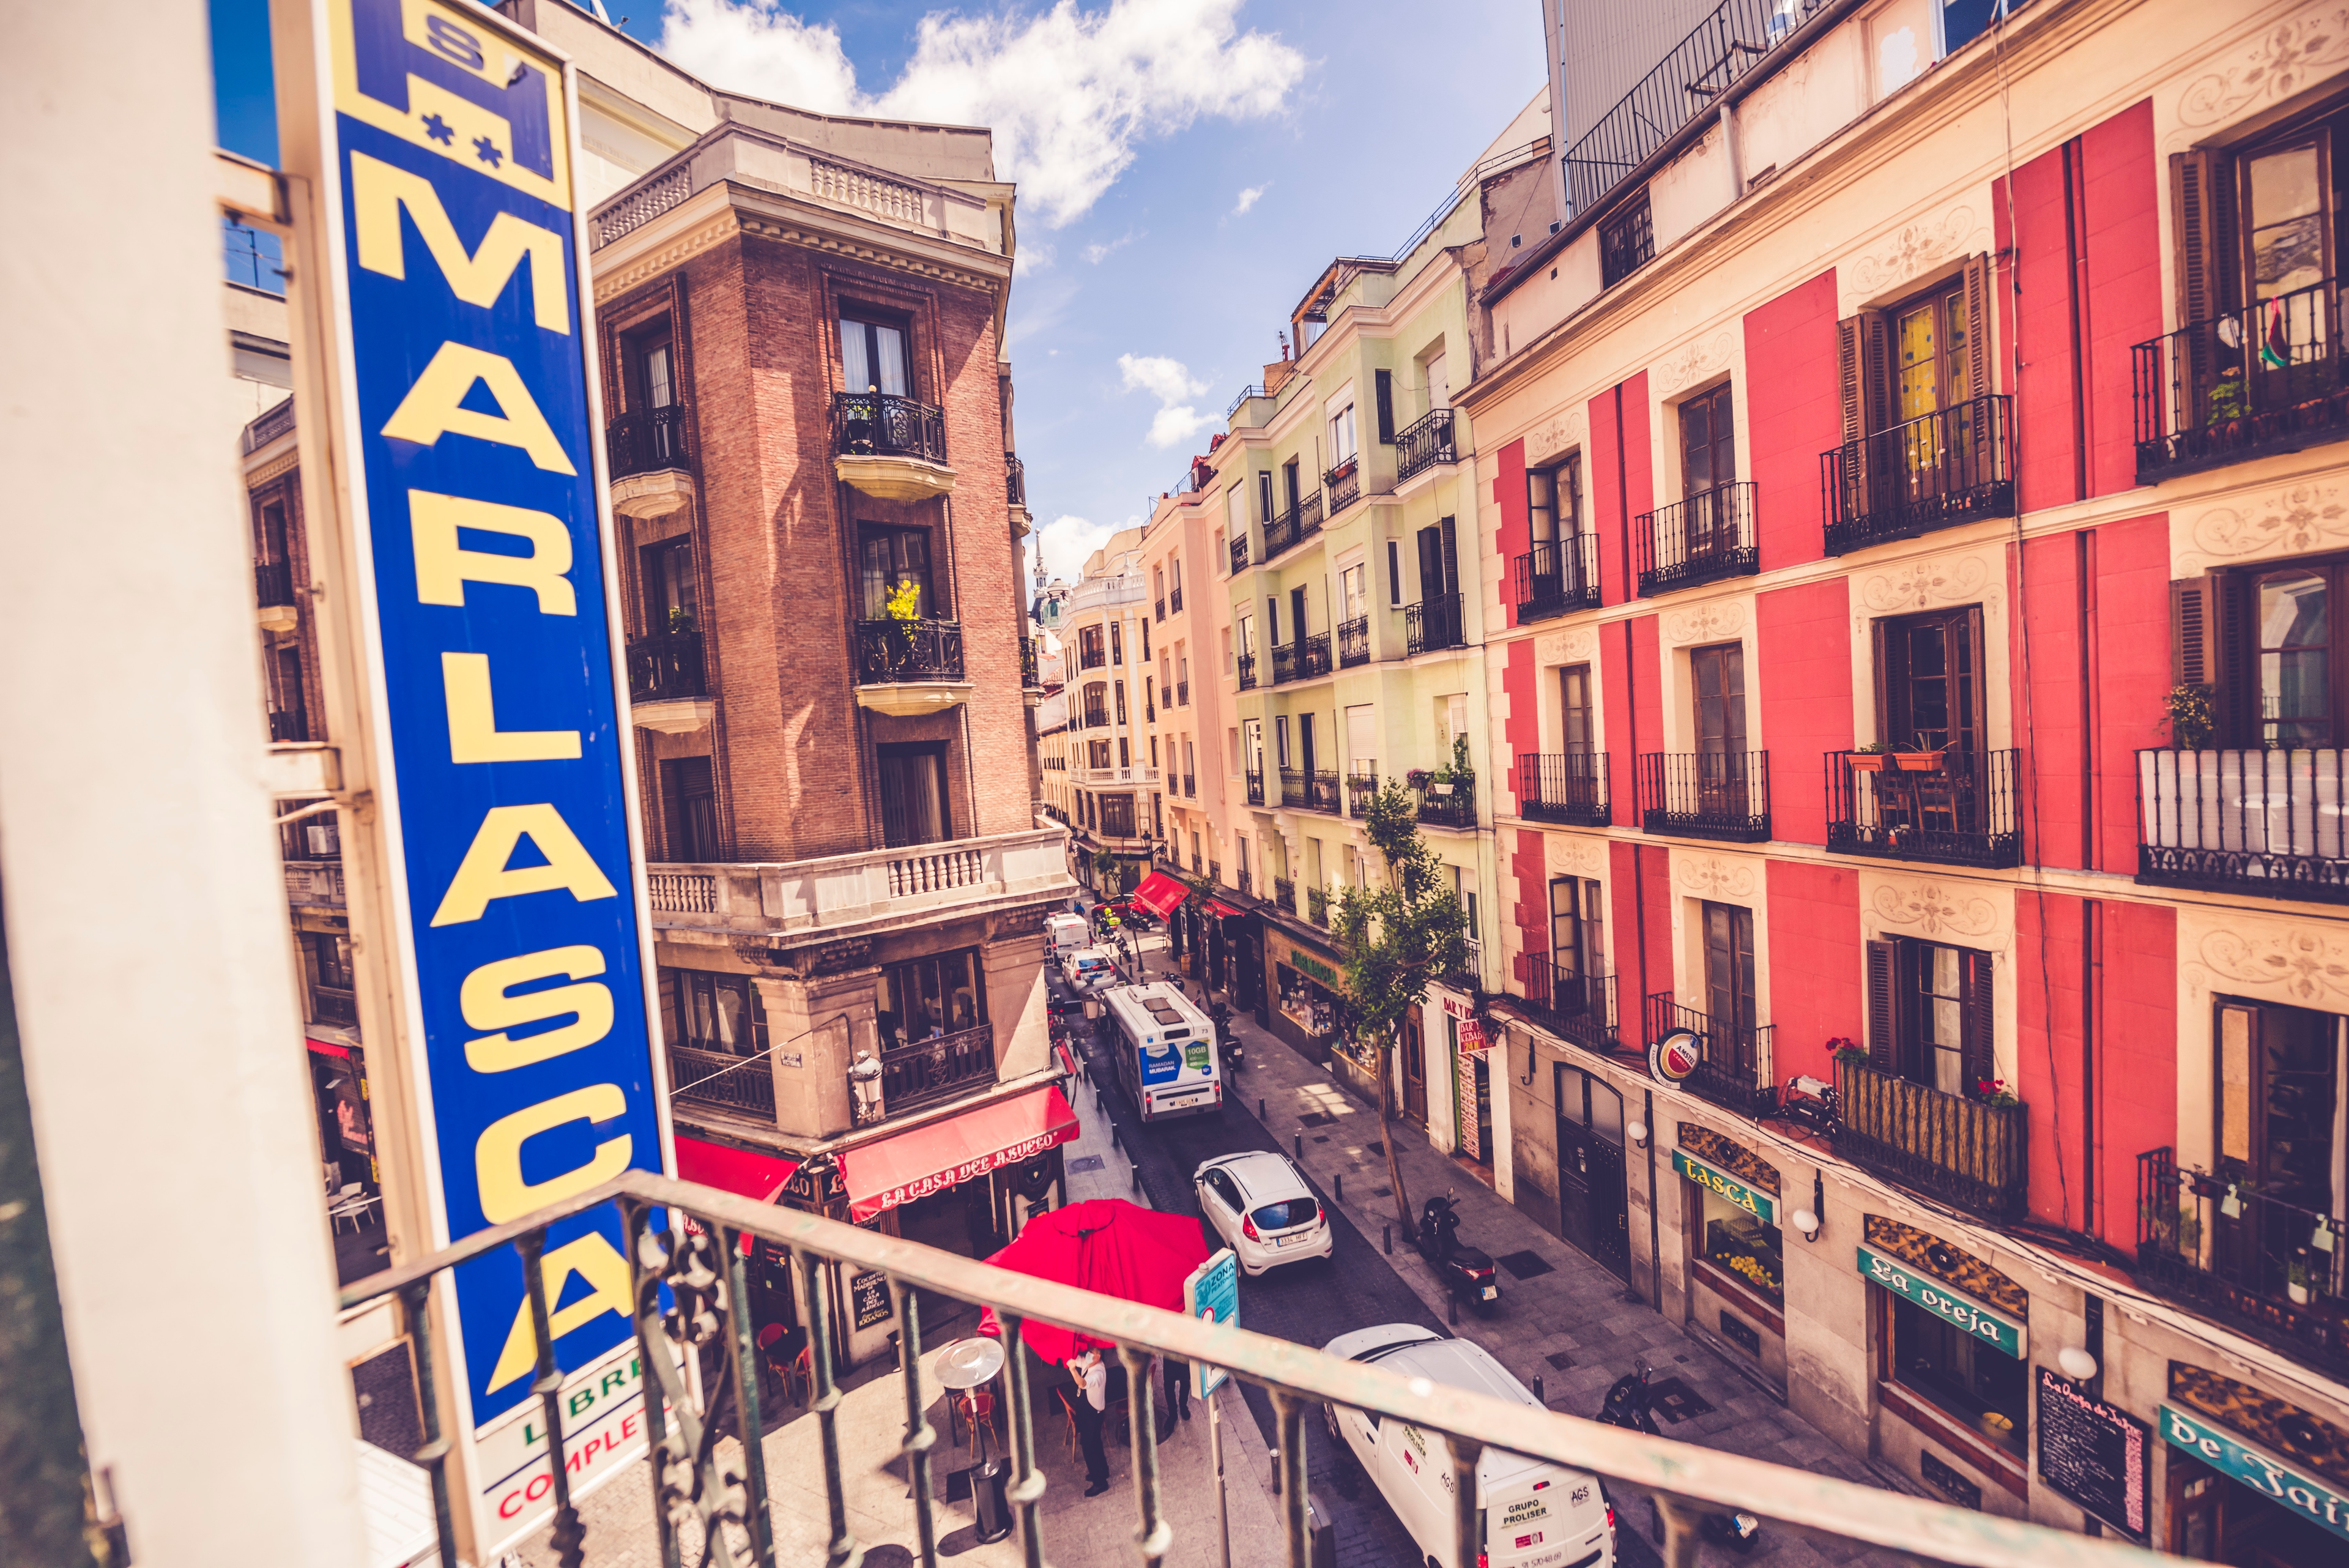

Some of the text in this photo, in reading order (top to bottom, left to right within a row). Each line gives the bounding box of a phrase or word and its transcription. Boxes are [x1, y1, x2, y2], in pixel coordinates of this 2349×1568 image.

[350, 150, 634, 1395] MARLASCA
[1444, 997, 1457, 1015] BAR
[1458, 1003, 1463, 1017] Y
[1460, 1021, 1474, 1033] BAR
[1188, 1046, 1206, 1055] 10GB
[1464, 1042, 1473, 1052] 24
[1677, 1046, 1695, 1065] AMSTEL
[881, 1135, 1053, 1208] LA CASA DEL ABUELO
[1684, 1159, 1757, 1213] tasca
[1211, 1262, 1234, 1287] ZONA
[1871, 1257, 1910, 1292] La
[2043, 1372, 2061, 1394] La
[524, 1355, 644, 1446] LBRE
[1405, 1425, 1427, 1458] PROLISER
[1442, 1472, 1455, 1493] AGS
[1572, 1487, 1589, 1503] AGS
[1504, 1507, 1546, 1525] PROLISER
[1508, 1499, 1539, 1513] GRUPO
